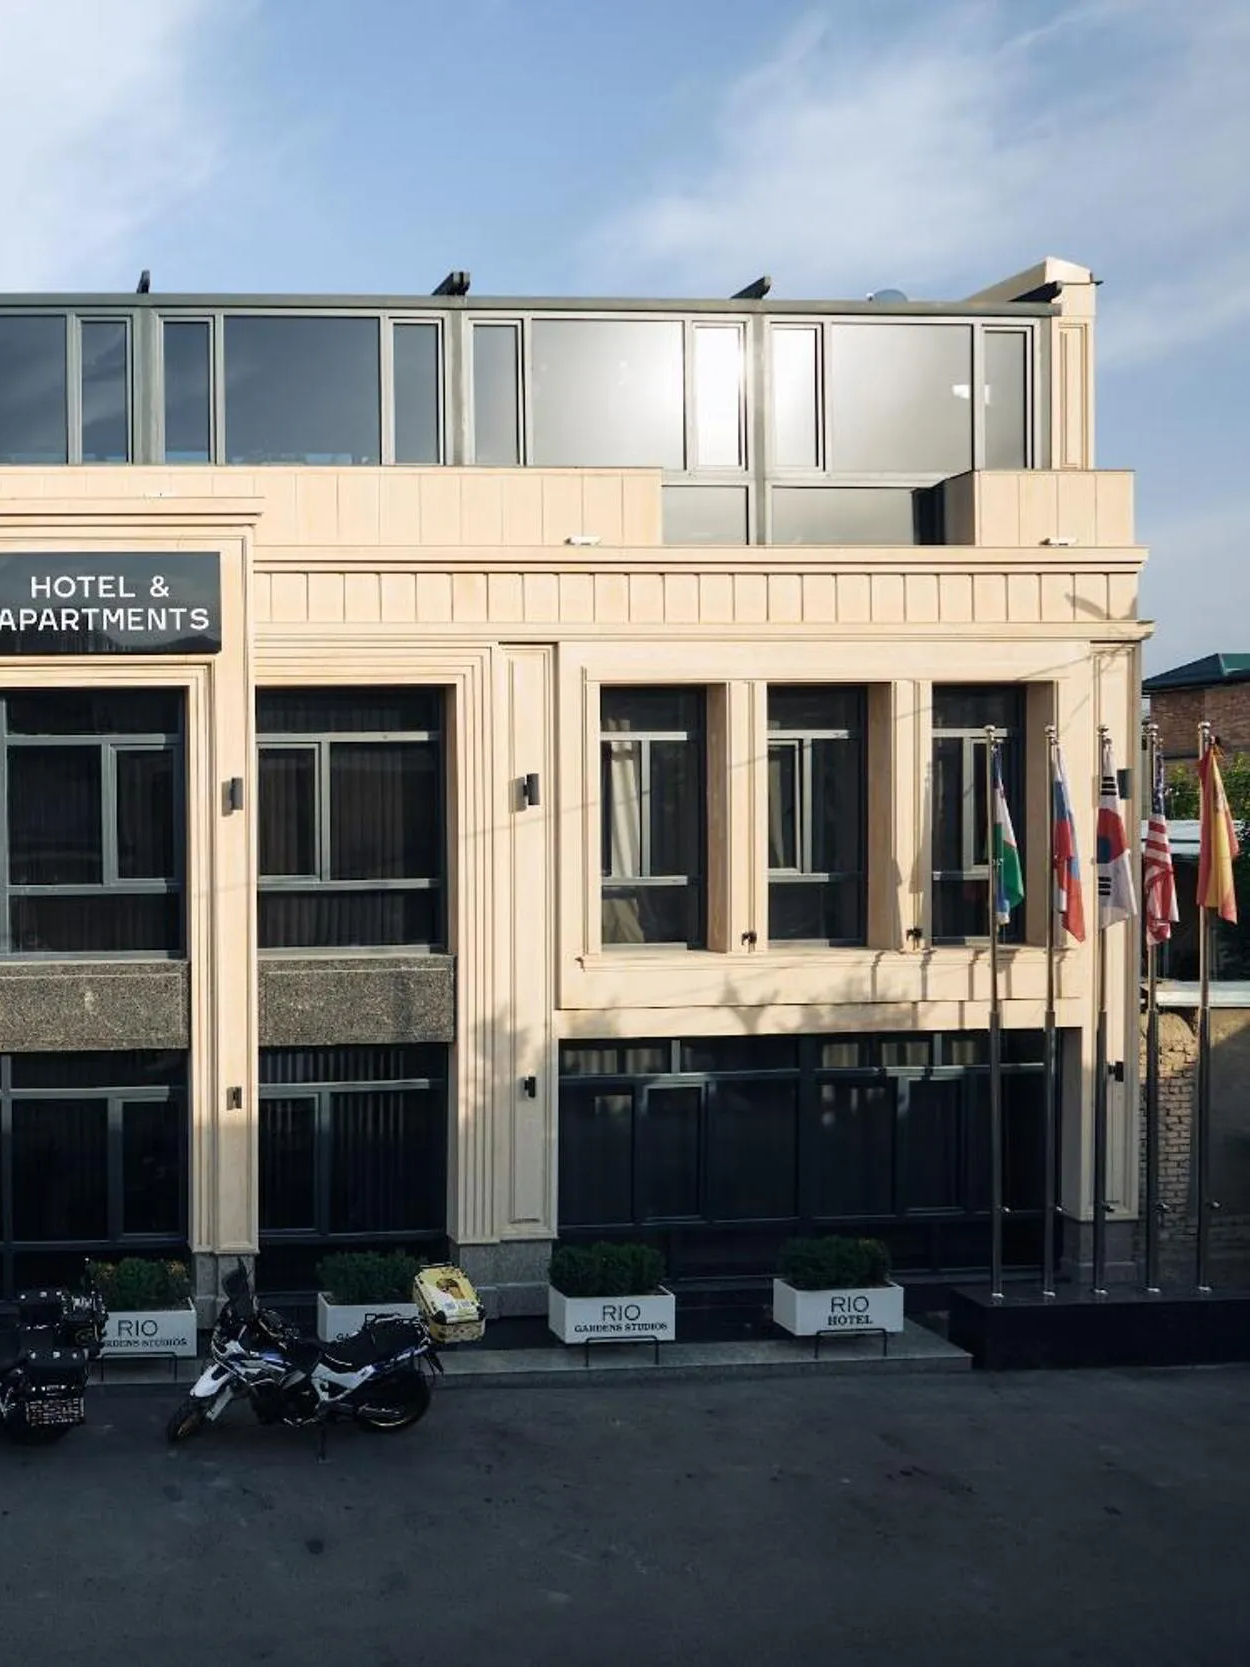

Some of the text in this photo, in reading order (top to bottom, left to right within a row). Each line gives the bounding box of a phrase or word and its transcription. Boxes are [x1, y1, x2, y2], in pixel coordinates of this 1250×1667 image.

[31, 575, 170, 599] HOTEL &
[602, 1304, 641, 1321] RIO
[831, 1296, 869, 1313] RIO
[117, 1319, 158, 1337] RIO
[574, 1322, 668, 1333] GARDENS STUDIOS
[827, 1314, 874, 1326] HOTEL
